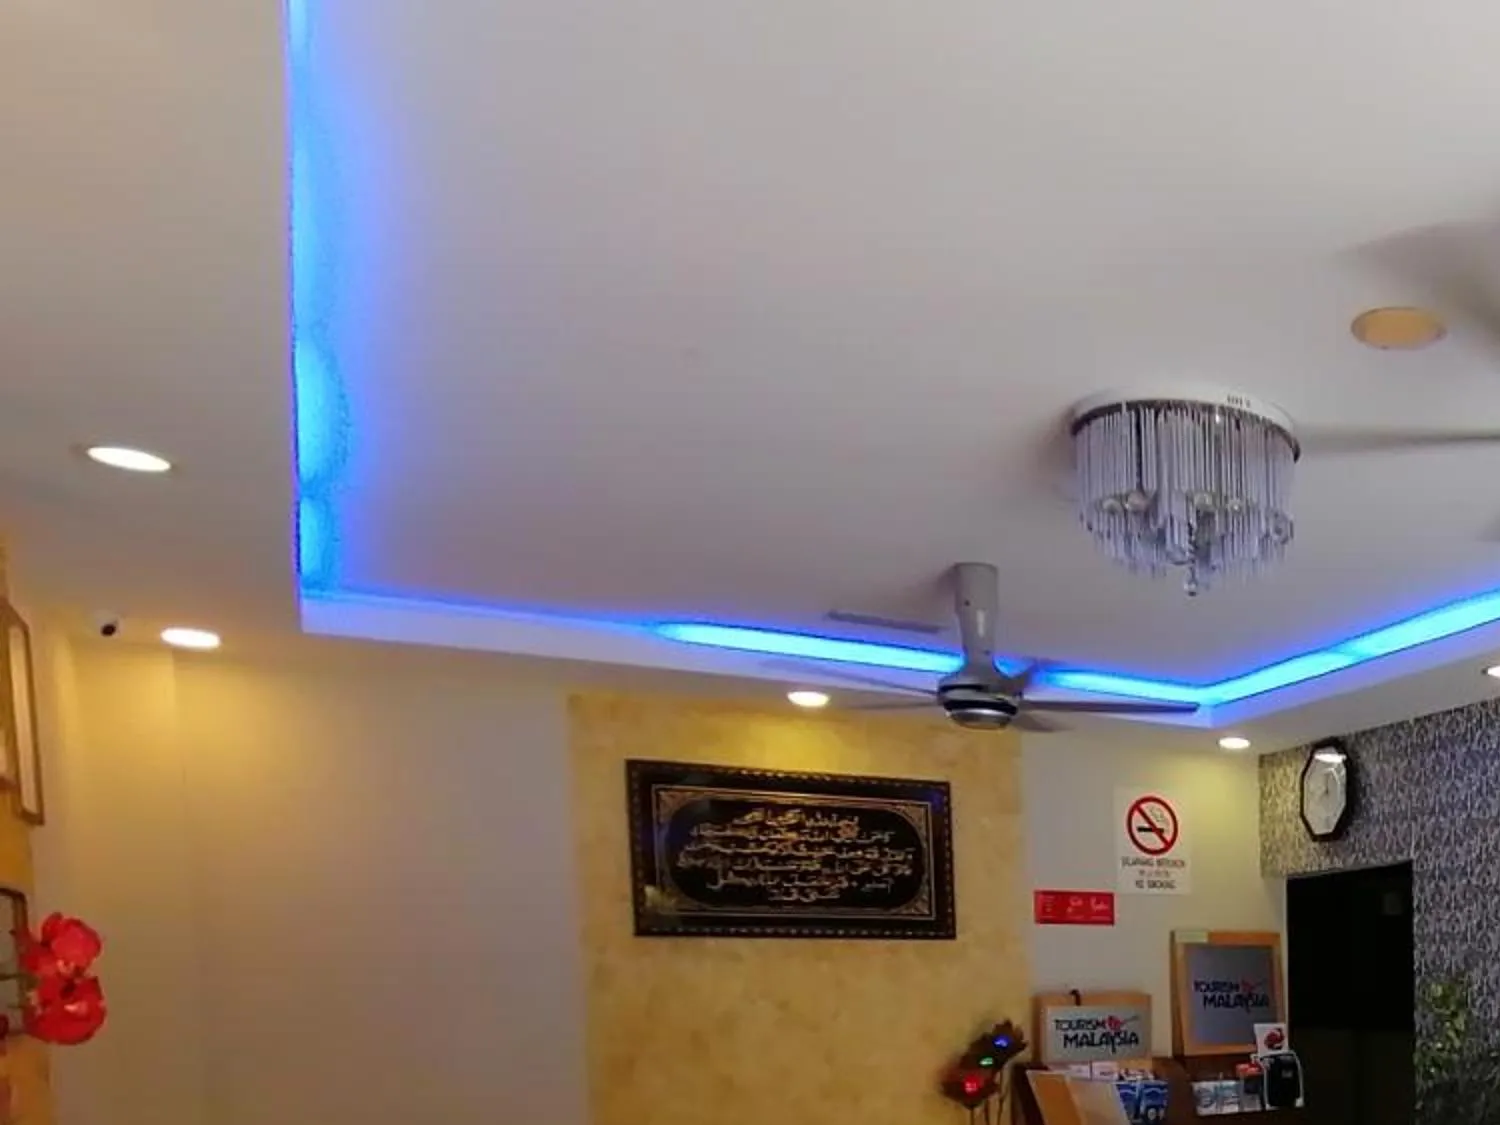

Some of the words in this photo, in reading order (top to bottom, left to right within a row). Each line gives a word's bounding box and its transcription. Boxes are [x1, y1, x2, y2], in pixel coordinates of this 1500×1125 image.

[1203, 992, 1270, 1014] MALAYSIA
[1055, 1019, 1106, 1031] TOURISM
[1063, 1031, 1139, 1054] MALAYSIA
